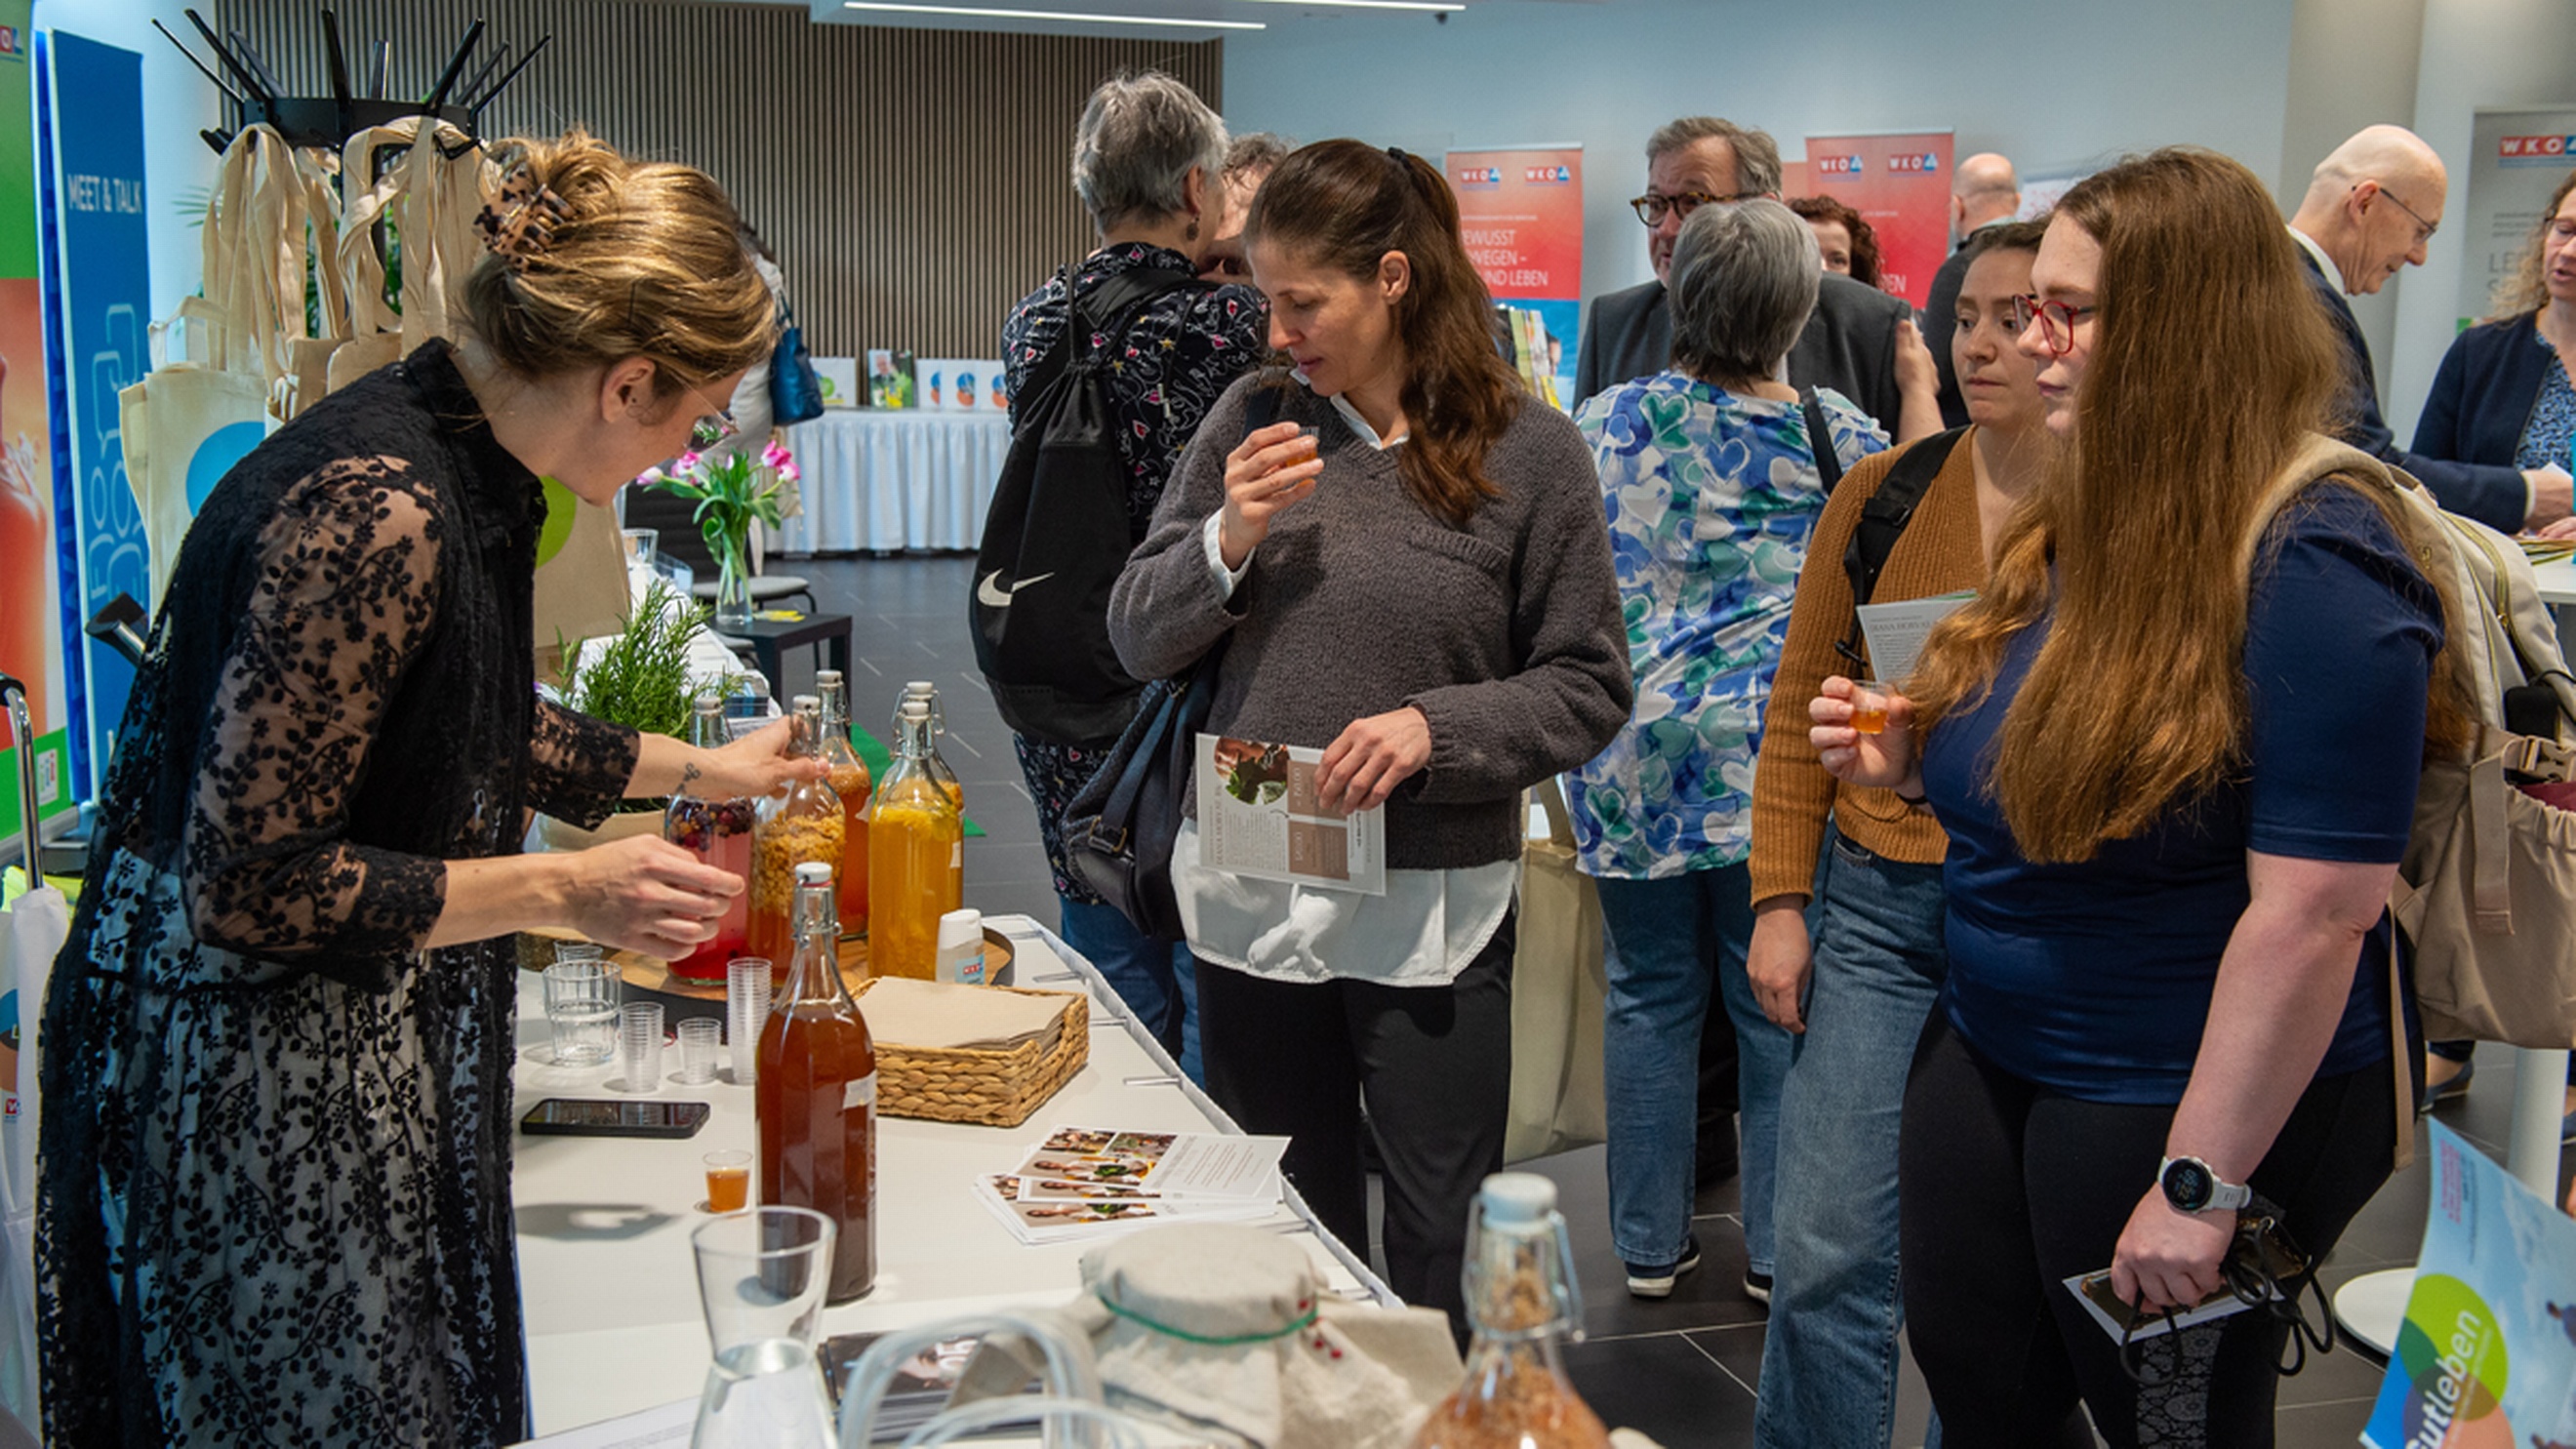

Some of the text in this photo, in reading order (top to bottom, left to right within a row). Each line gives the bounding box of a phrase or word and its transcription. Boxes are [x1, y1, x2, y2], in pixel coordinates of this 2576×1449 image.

[2501, 138, 2563, 154] WKO
[1889, 155, 1922, 170] WKO
[67, 174, 142, 214] MEET & TALK
[1509, 269, 1550, 287] LEBEN
